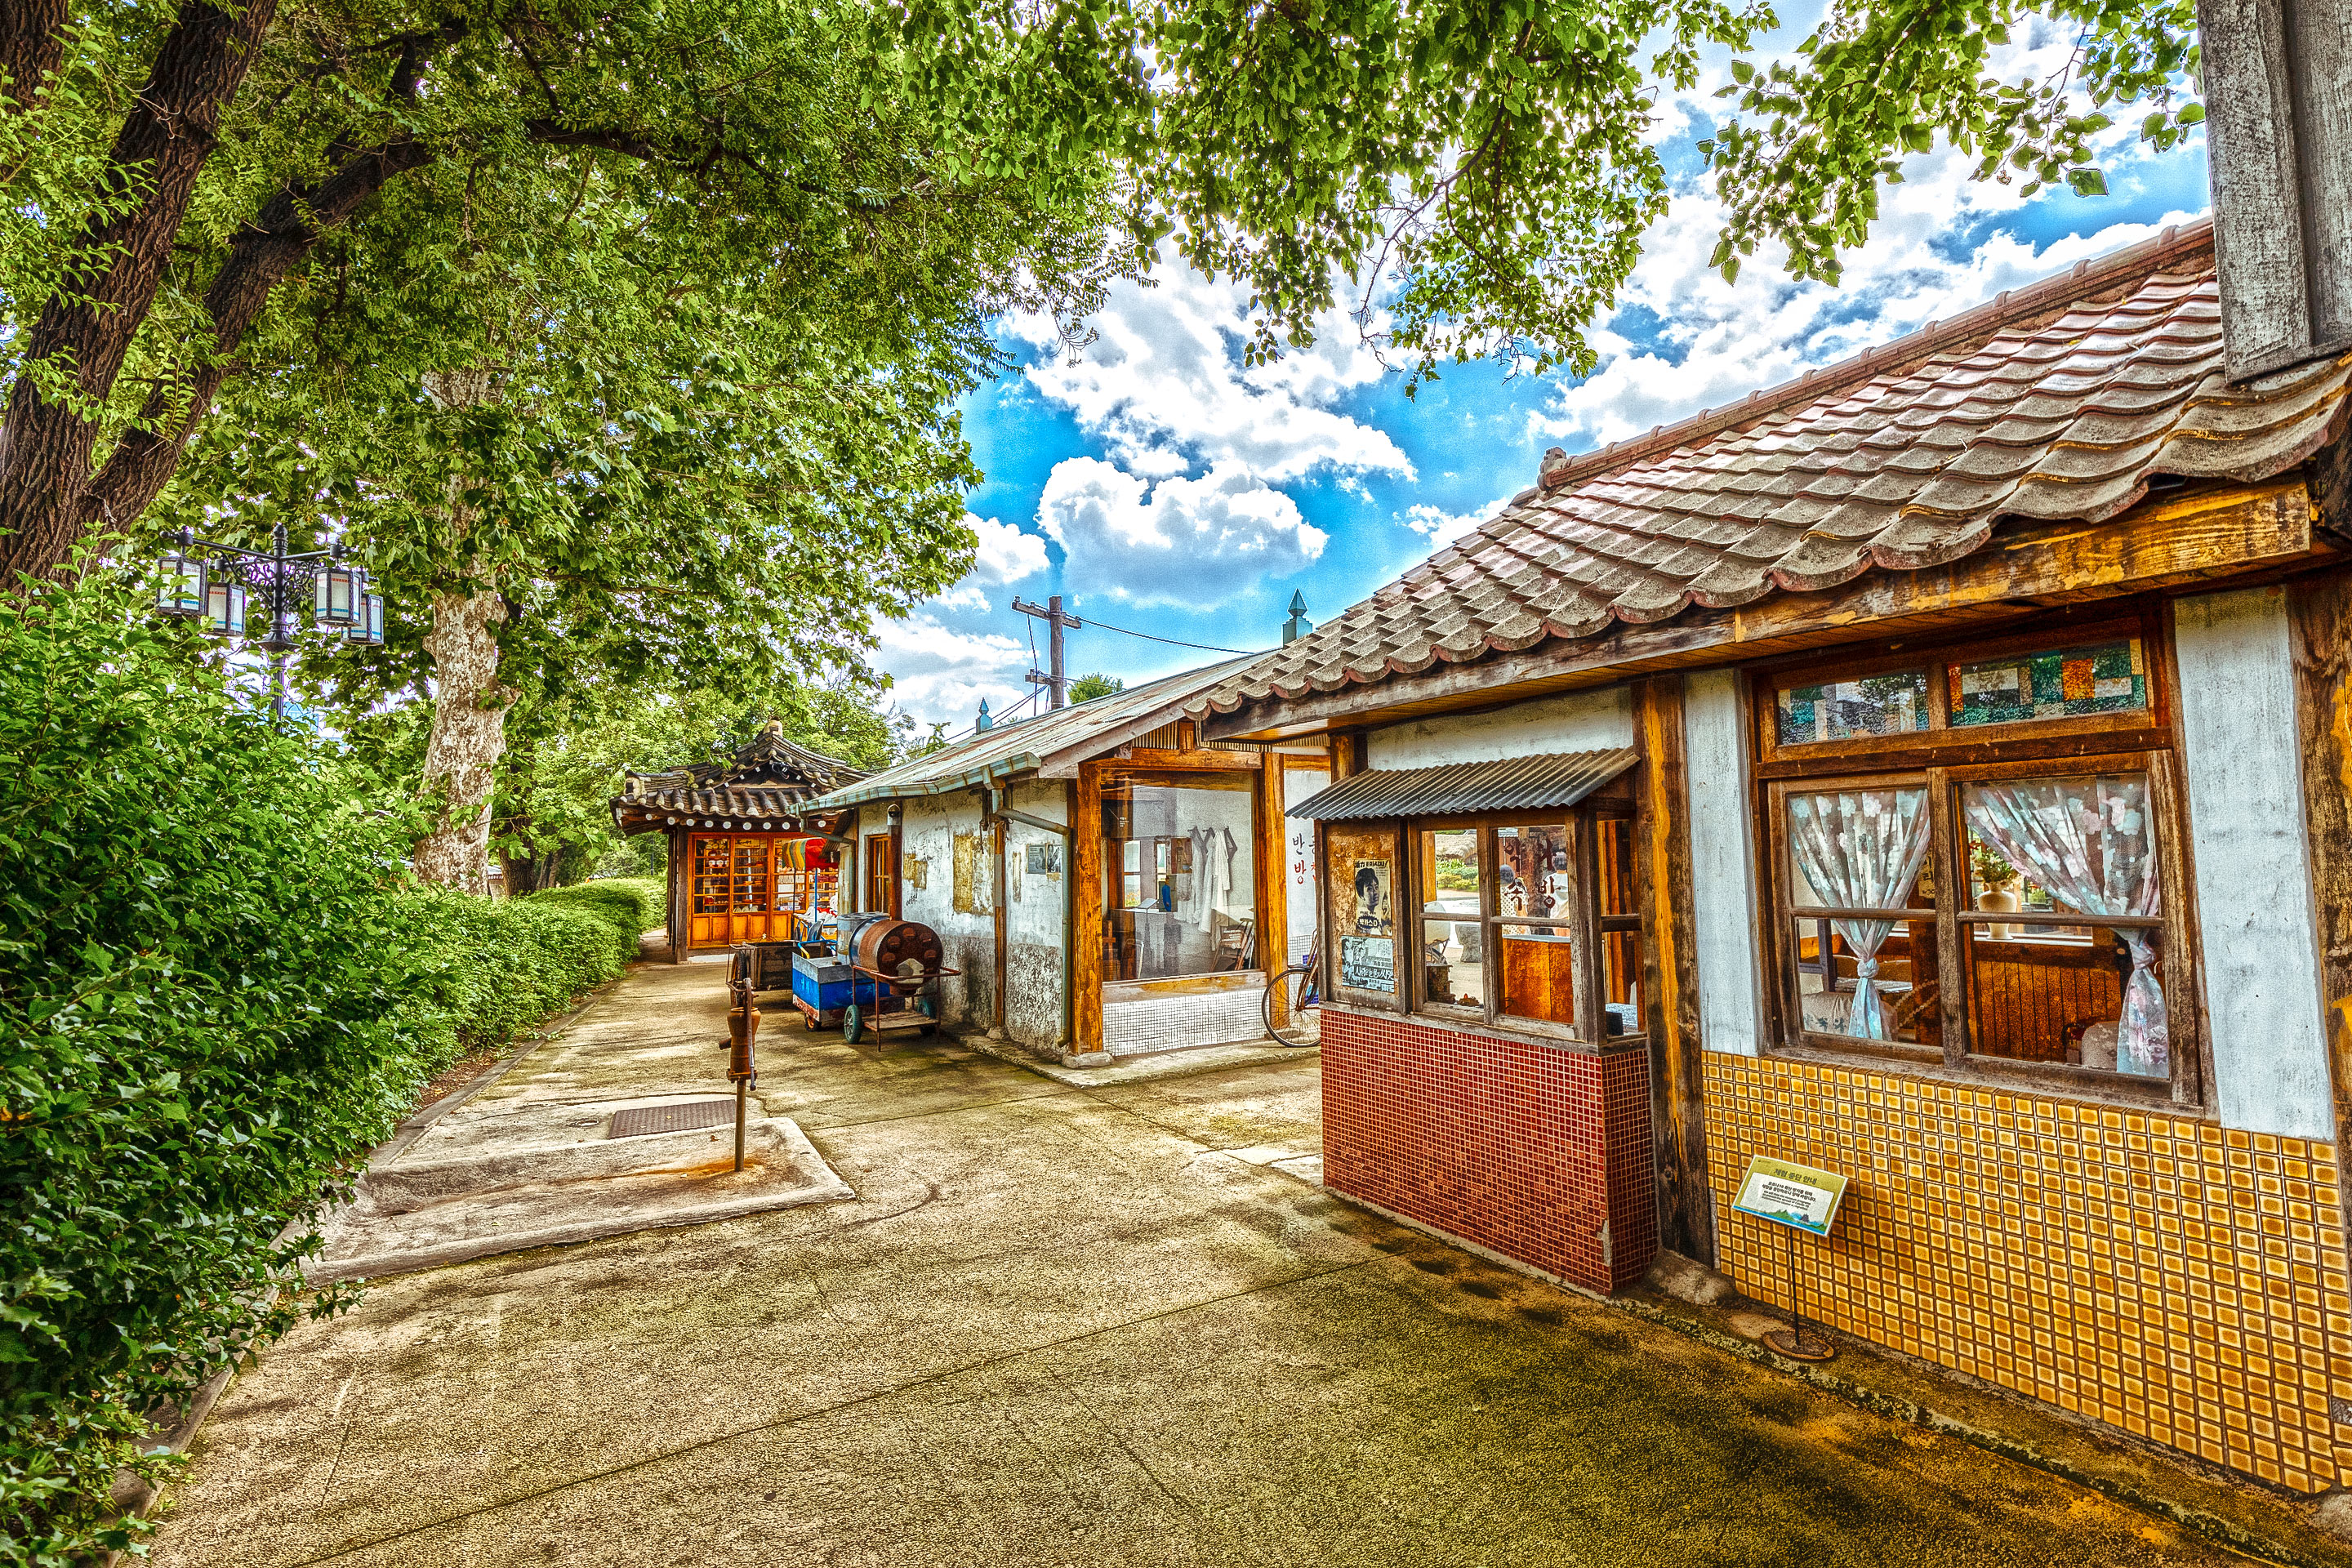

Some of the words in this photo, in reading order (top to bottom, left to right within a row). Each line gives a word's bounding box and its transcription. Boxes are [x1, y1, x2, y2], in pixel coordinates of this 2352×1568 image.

[1774, 1169, 1788, 1177] 체험
[1788, 1172, 1802, 1181] 중단
[1803, 1176, 1818, 1185] 안내
